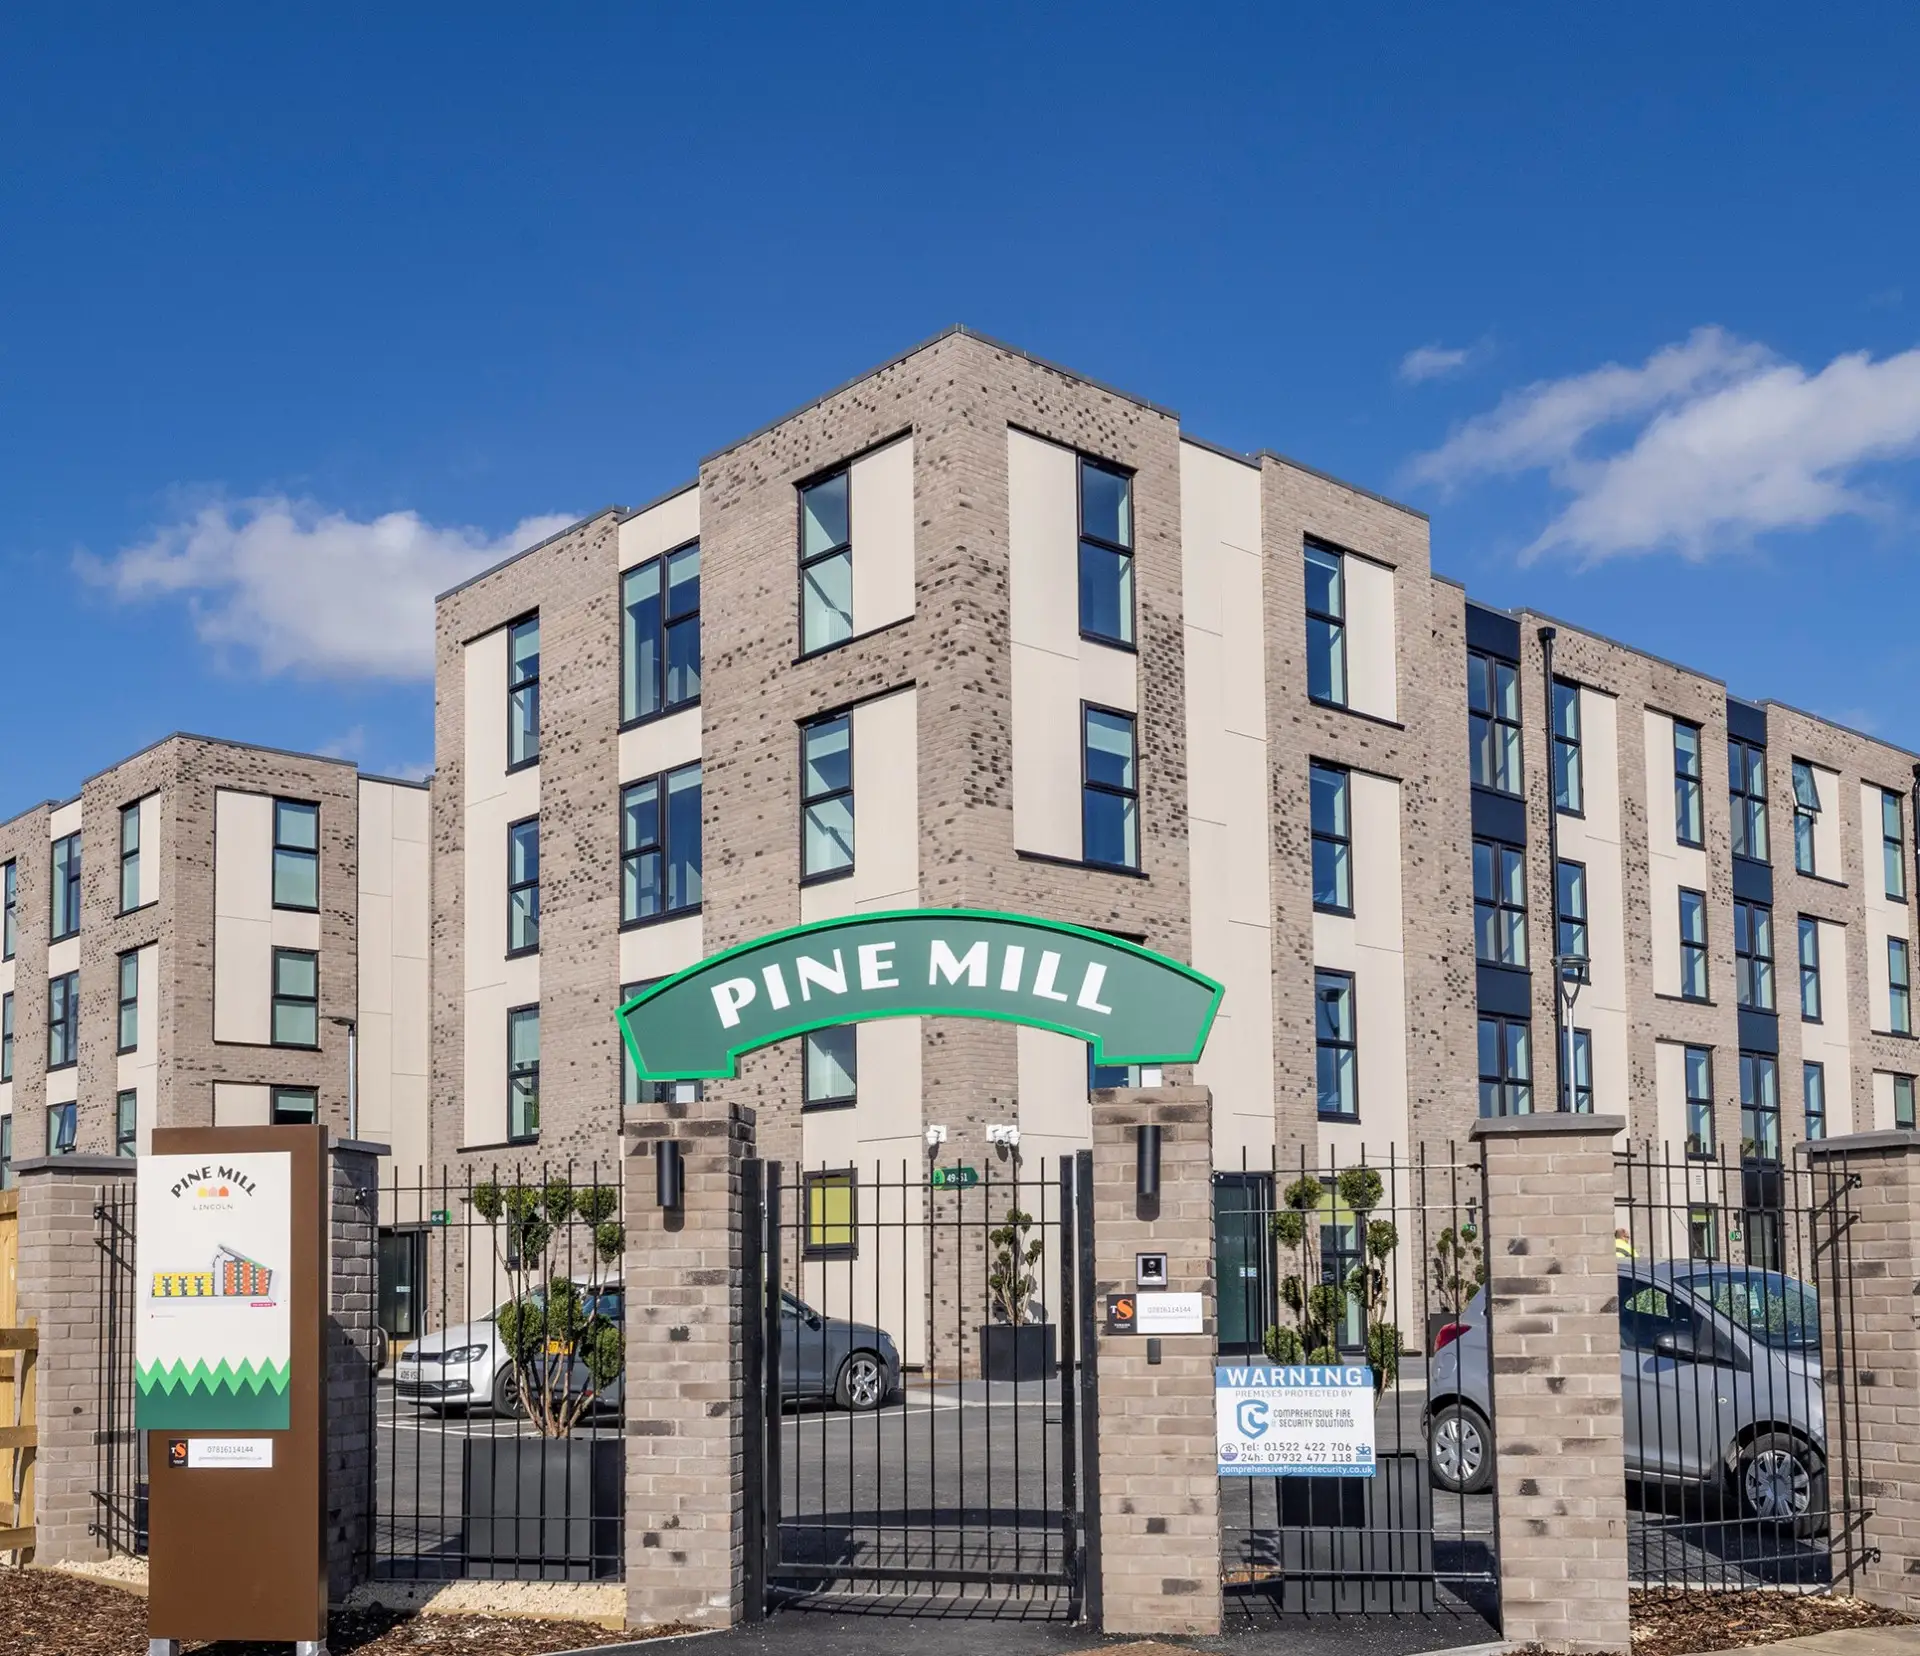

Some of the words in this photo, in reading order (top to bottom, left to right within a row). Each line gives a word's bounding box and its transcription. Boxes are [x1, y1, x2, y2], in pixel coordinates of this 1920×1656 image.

[710, 941, 899, 1029] PINE
[928, 940, 1112, 1015] MILL
[171, 1166, 212, 1198] PINE
[217, 1165, 256, 1197] MILL
[193, 1203, 233, 1211] LINCOLN
[1226, 1368, 1363, 1386] WARNING
[1235, 1389, 1283, 1398] PREMISES
[1285, 1389, 1339, 1398] PROTECTED
[1335, 1409, 1351, 1418] FIRE
[1279, 1418, 1313, 1428] SECURITY
[207, 1446, 254, 1454] 07816114144
[1241, 1443, 1260, 1451] Tel:
[1264, 1443, 1300, 1451] 01522
[1304, 1443, 1326, 1451] 422
[1331, 1443, 1351, 1451] 706
[1241, 1453, 1264, 1462] 24h:
[1268, 1453, 1302, 1462] 07932
[1306, 1453, 1327, 1462] 477
[1332, 1453, 1352, 1462] 118
[1220, 1465, 1373, 1475] comprehensivefireandsecurity.co.uk
